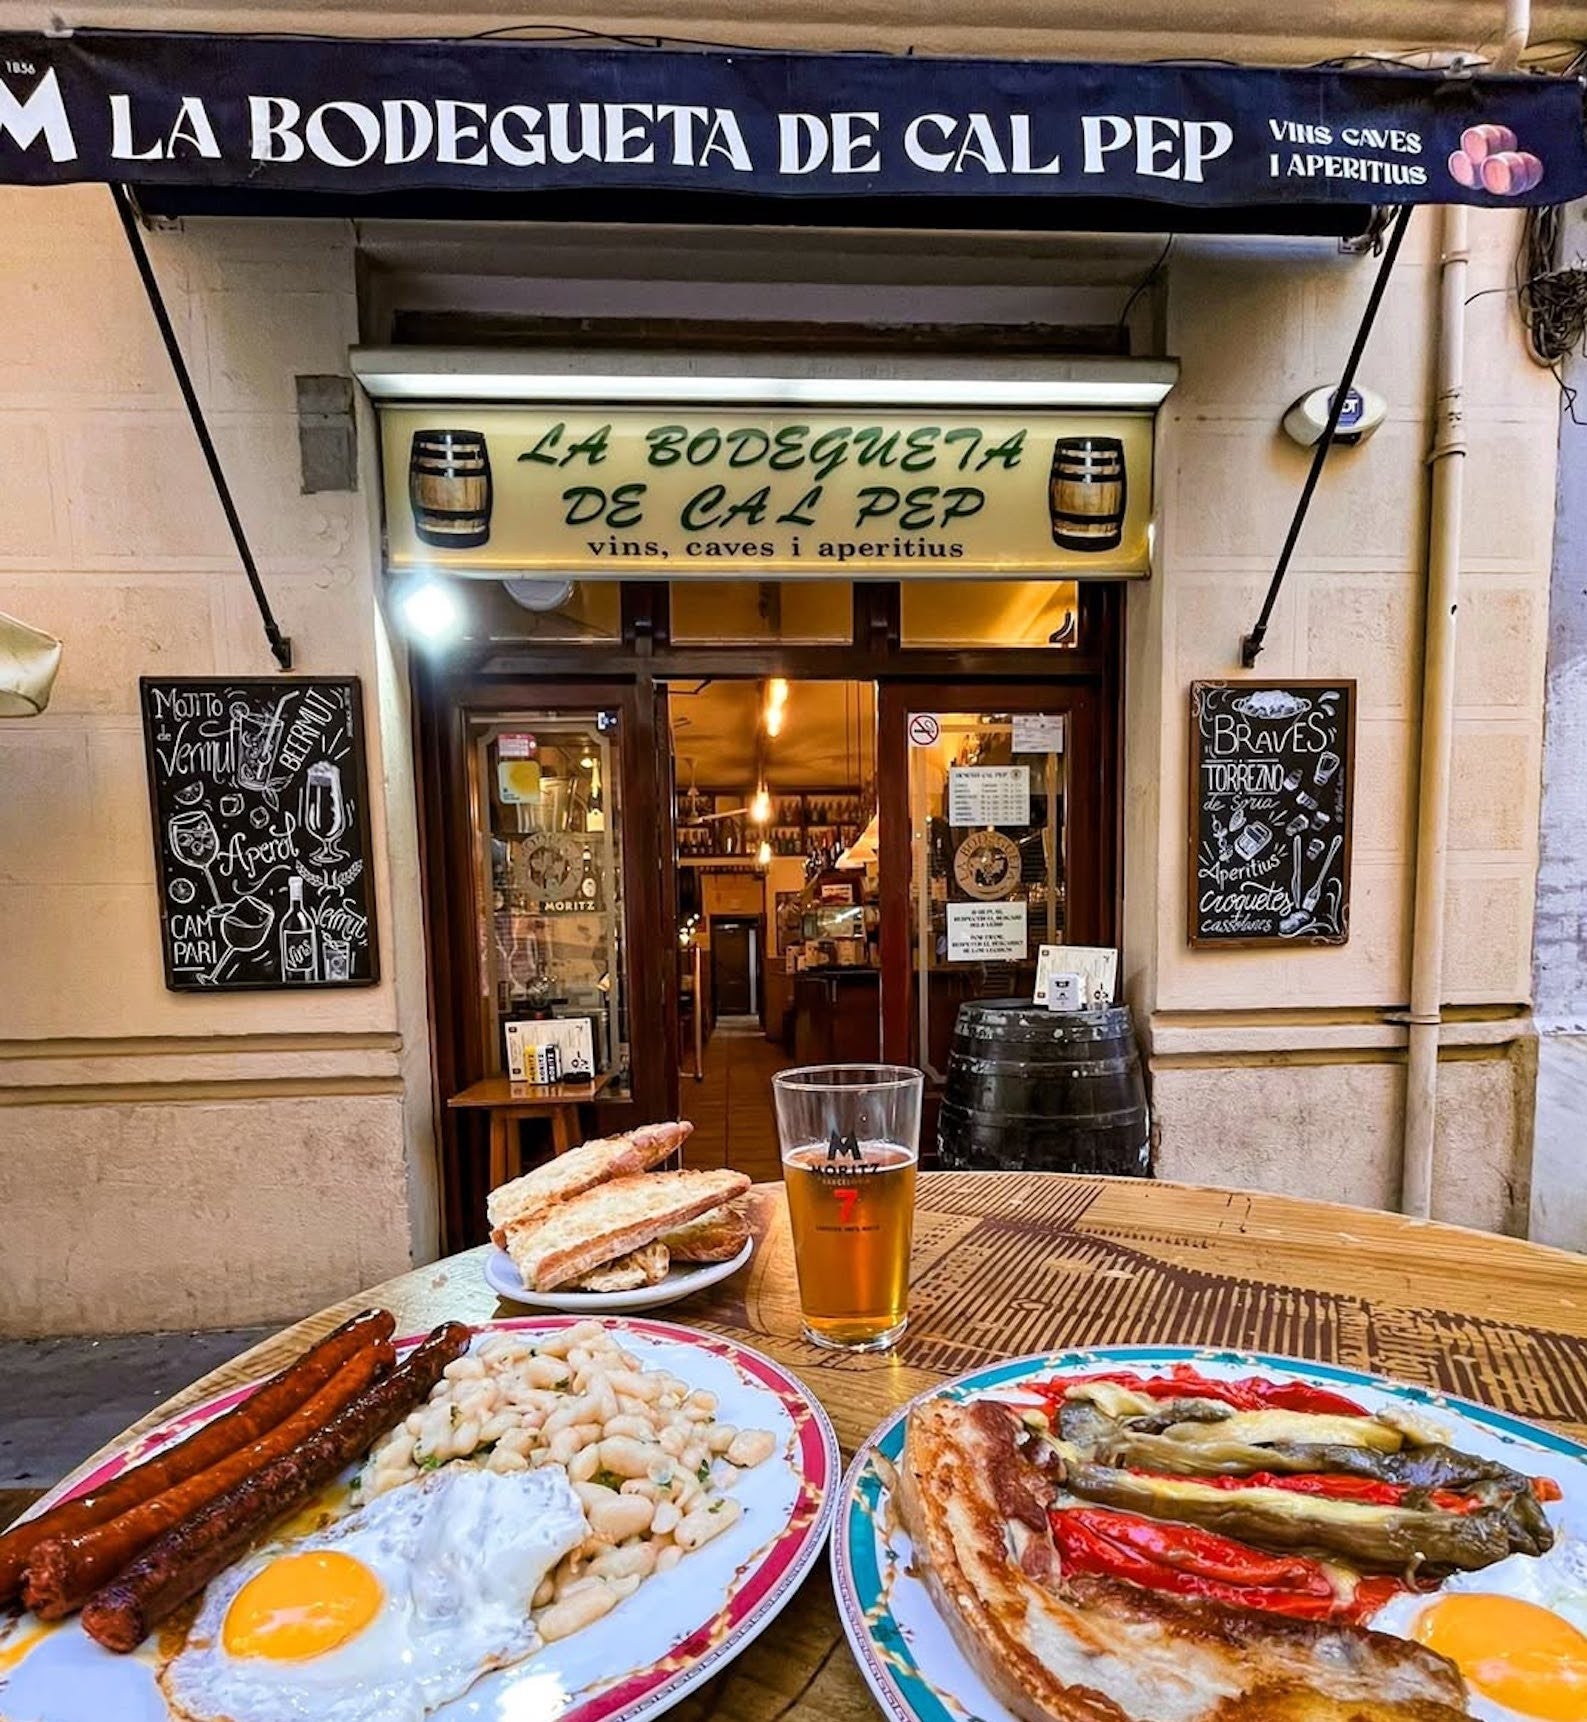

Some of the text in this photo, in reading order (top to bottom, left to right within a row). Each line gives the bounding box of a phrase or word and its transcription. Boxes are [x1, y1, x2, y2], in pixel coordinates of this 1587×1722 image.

[6, 60, 36, 75] 1856
[110, 95, 1233, 183] LA BODEGUETA DE CAL PEP
[1268, 119, 1422, 154] VINS CAVES
[1270, 153, 1427, 185] I APERITIUS
[517, 423, 1027, 483] LA BODEGUETA
[562, 483, 987, 533] DE CAL PEP
[586, 535, 964, 563] vins, caves i aperitius
[279, 686, 338, 772] BEERMUT
[1214, 711, 1328, 755] BRAVES
[1201, 764, 1285, 793] TORREZNO
[216, 811, 300, 878] Aperol
[1198, 853, 1281, 891] Aperitius
[544, 901, 595, 911] MORITZ
[171, 914, 214, 940] CAM
[174, 940, 217, 965] PARI
[812, 1163, 880, 1177] MORITZ
[833, 1188, 858, 1224] 7
